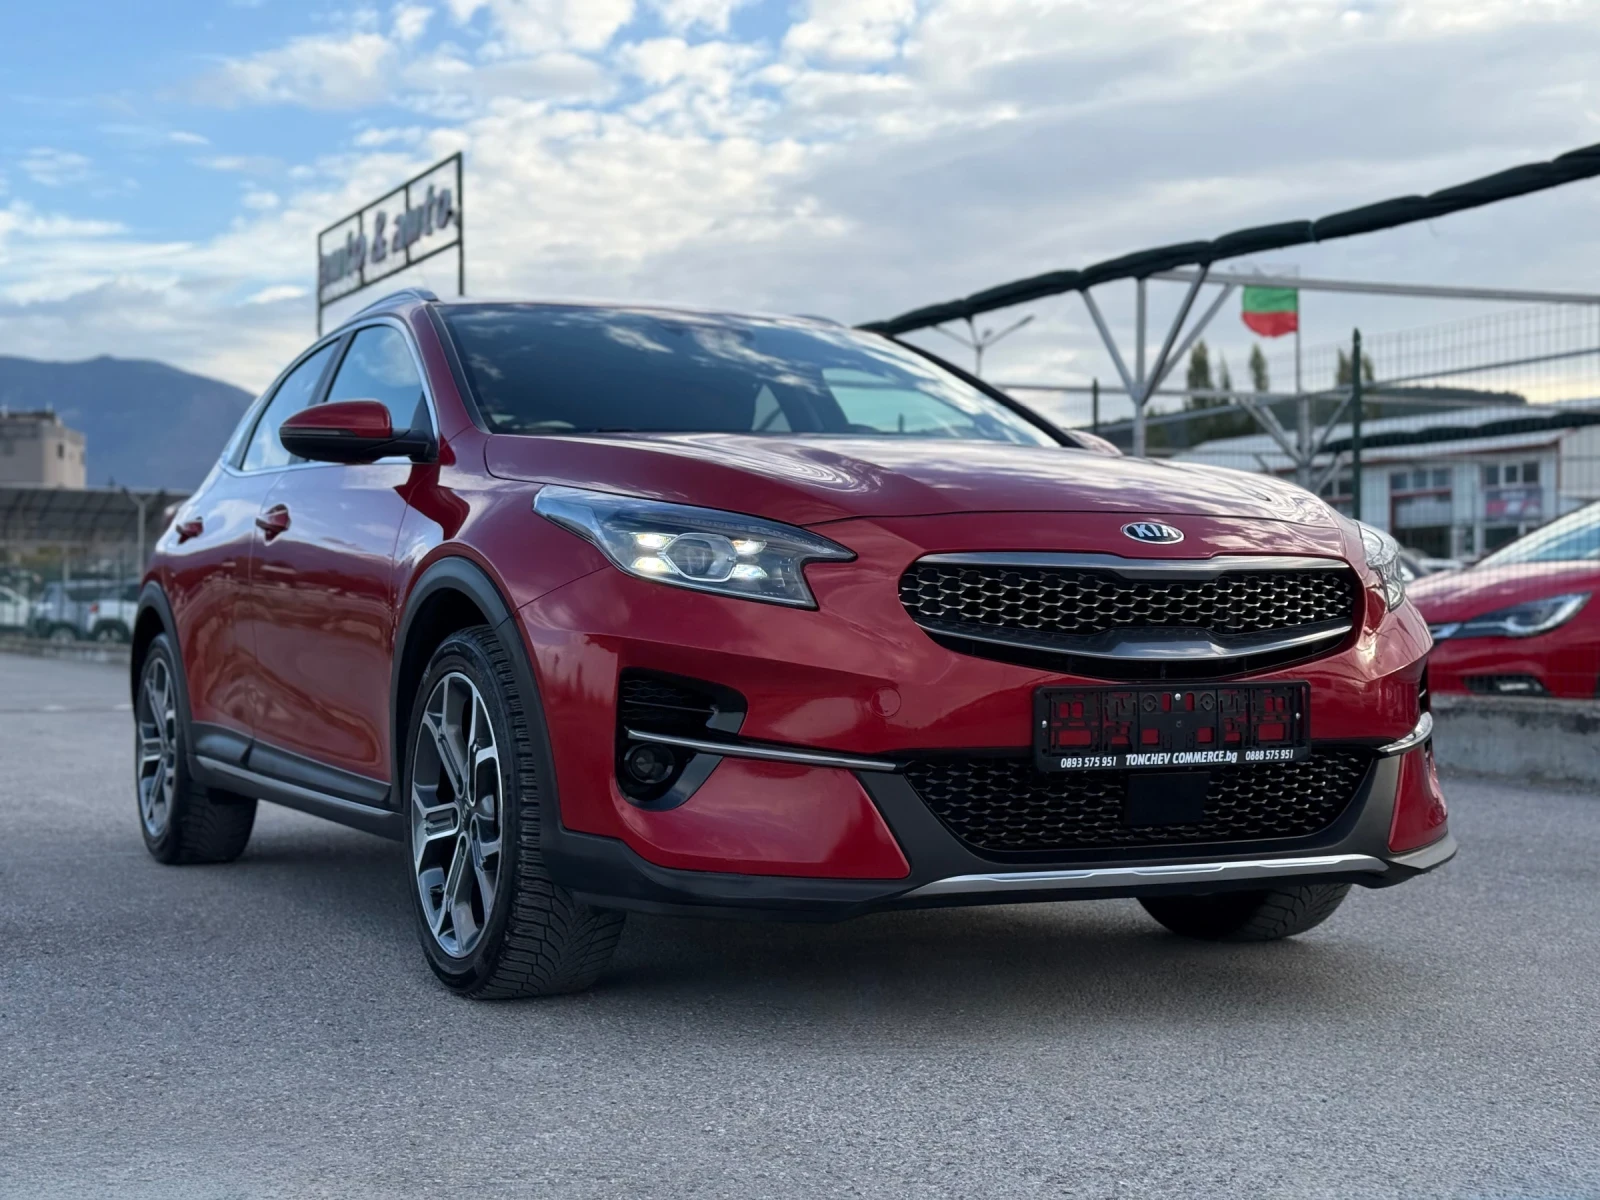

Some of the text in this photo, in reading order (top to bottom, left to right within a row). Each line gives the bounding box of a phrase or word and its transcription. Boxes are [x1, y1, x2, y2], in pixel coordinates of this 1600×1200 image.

[371, 209, 387, 263] &
[1131, 524, 1179, 538] KIA
[1060, 749, 1294, 768] 0893 575 951 TONCHEV COMMERCE.bg 0888 575 951
